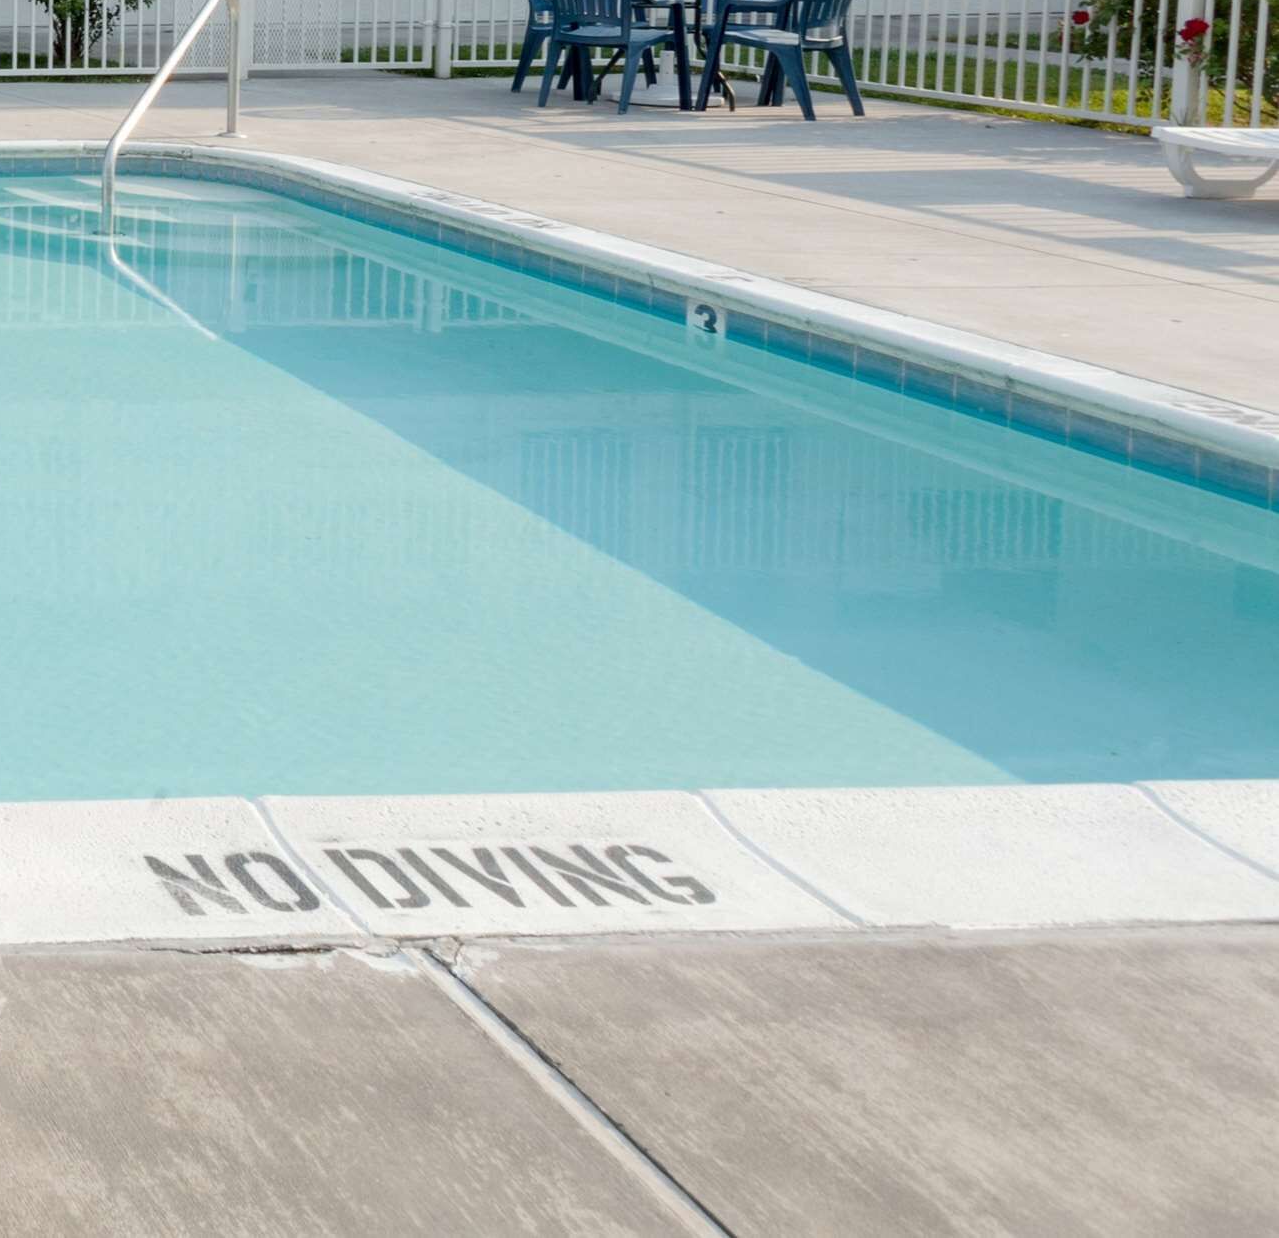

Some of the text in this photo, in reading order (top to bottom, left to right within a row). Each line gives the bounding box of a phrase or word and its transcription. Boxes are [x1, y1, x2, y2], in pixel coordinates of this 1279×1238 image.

[692, 303, 719, 334] 3
[143, 844, 716, 916] NO DIVING
